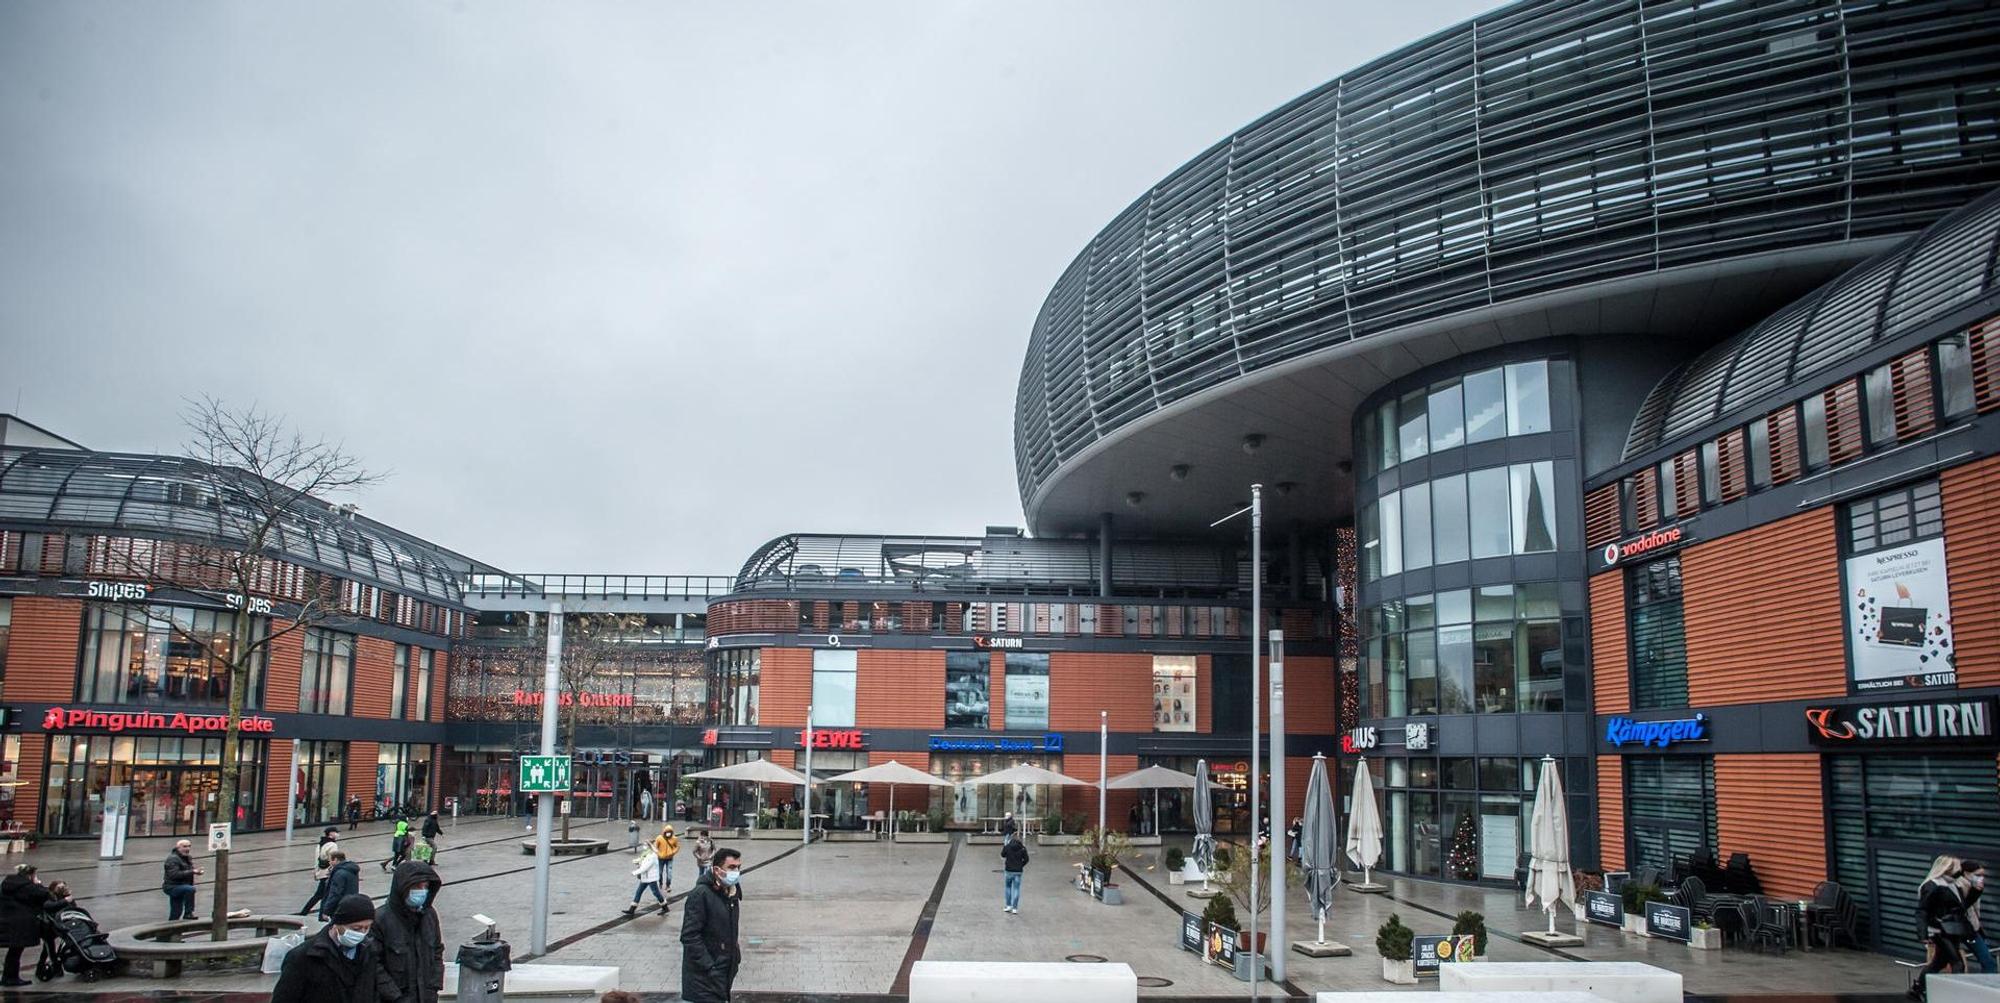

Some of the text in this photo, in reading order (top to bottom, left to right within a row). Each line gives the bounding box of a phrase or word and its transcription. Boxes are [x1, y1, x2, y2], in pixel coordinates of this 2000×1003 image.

[1623, 528, 1681, 555] vodafone
[1876, 550, 1919, 565] NESPRESSO
[88, 581, 147, 601] snipes
[225, 593, 272, 614] snpes
[991, 637, 1023, 648] SATURN
[68, 709, 273, 733] Pinguin Apoteke
[1857, 702, 1987, 739] SATURN
[801, 730, 863, 748] REWE
[1606, 717, 1704, 747] Kämpgen
[928, 737, 1034, 751] Deutsche Bank
